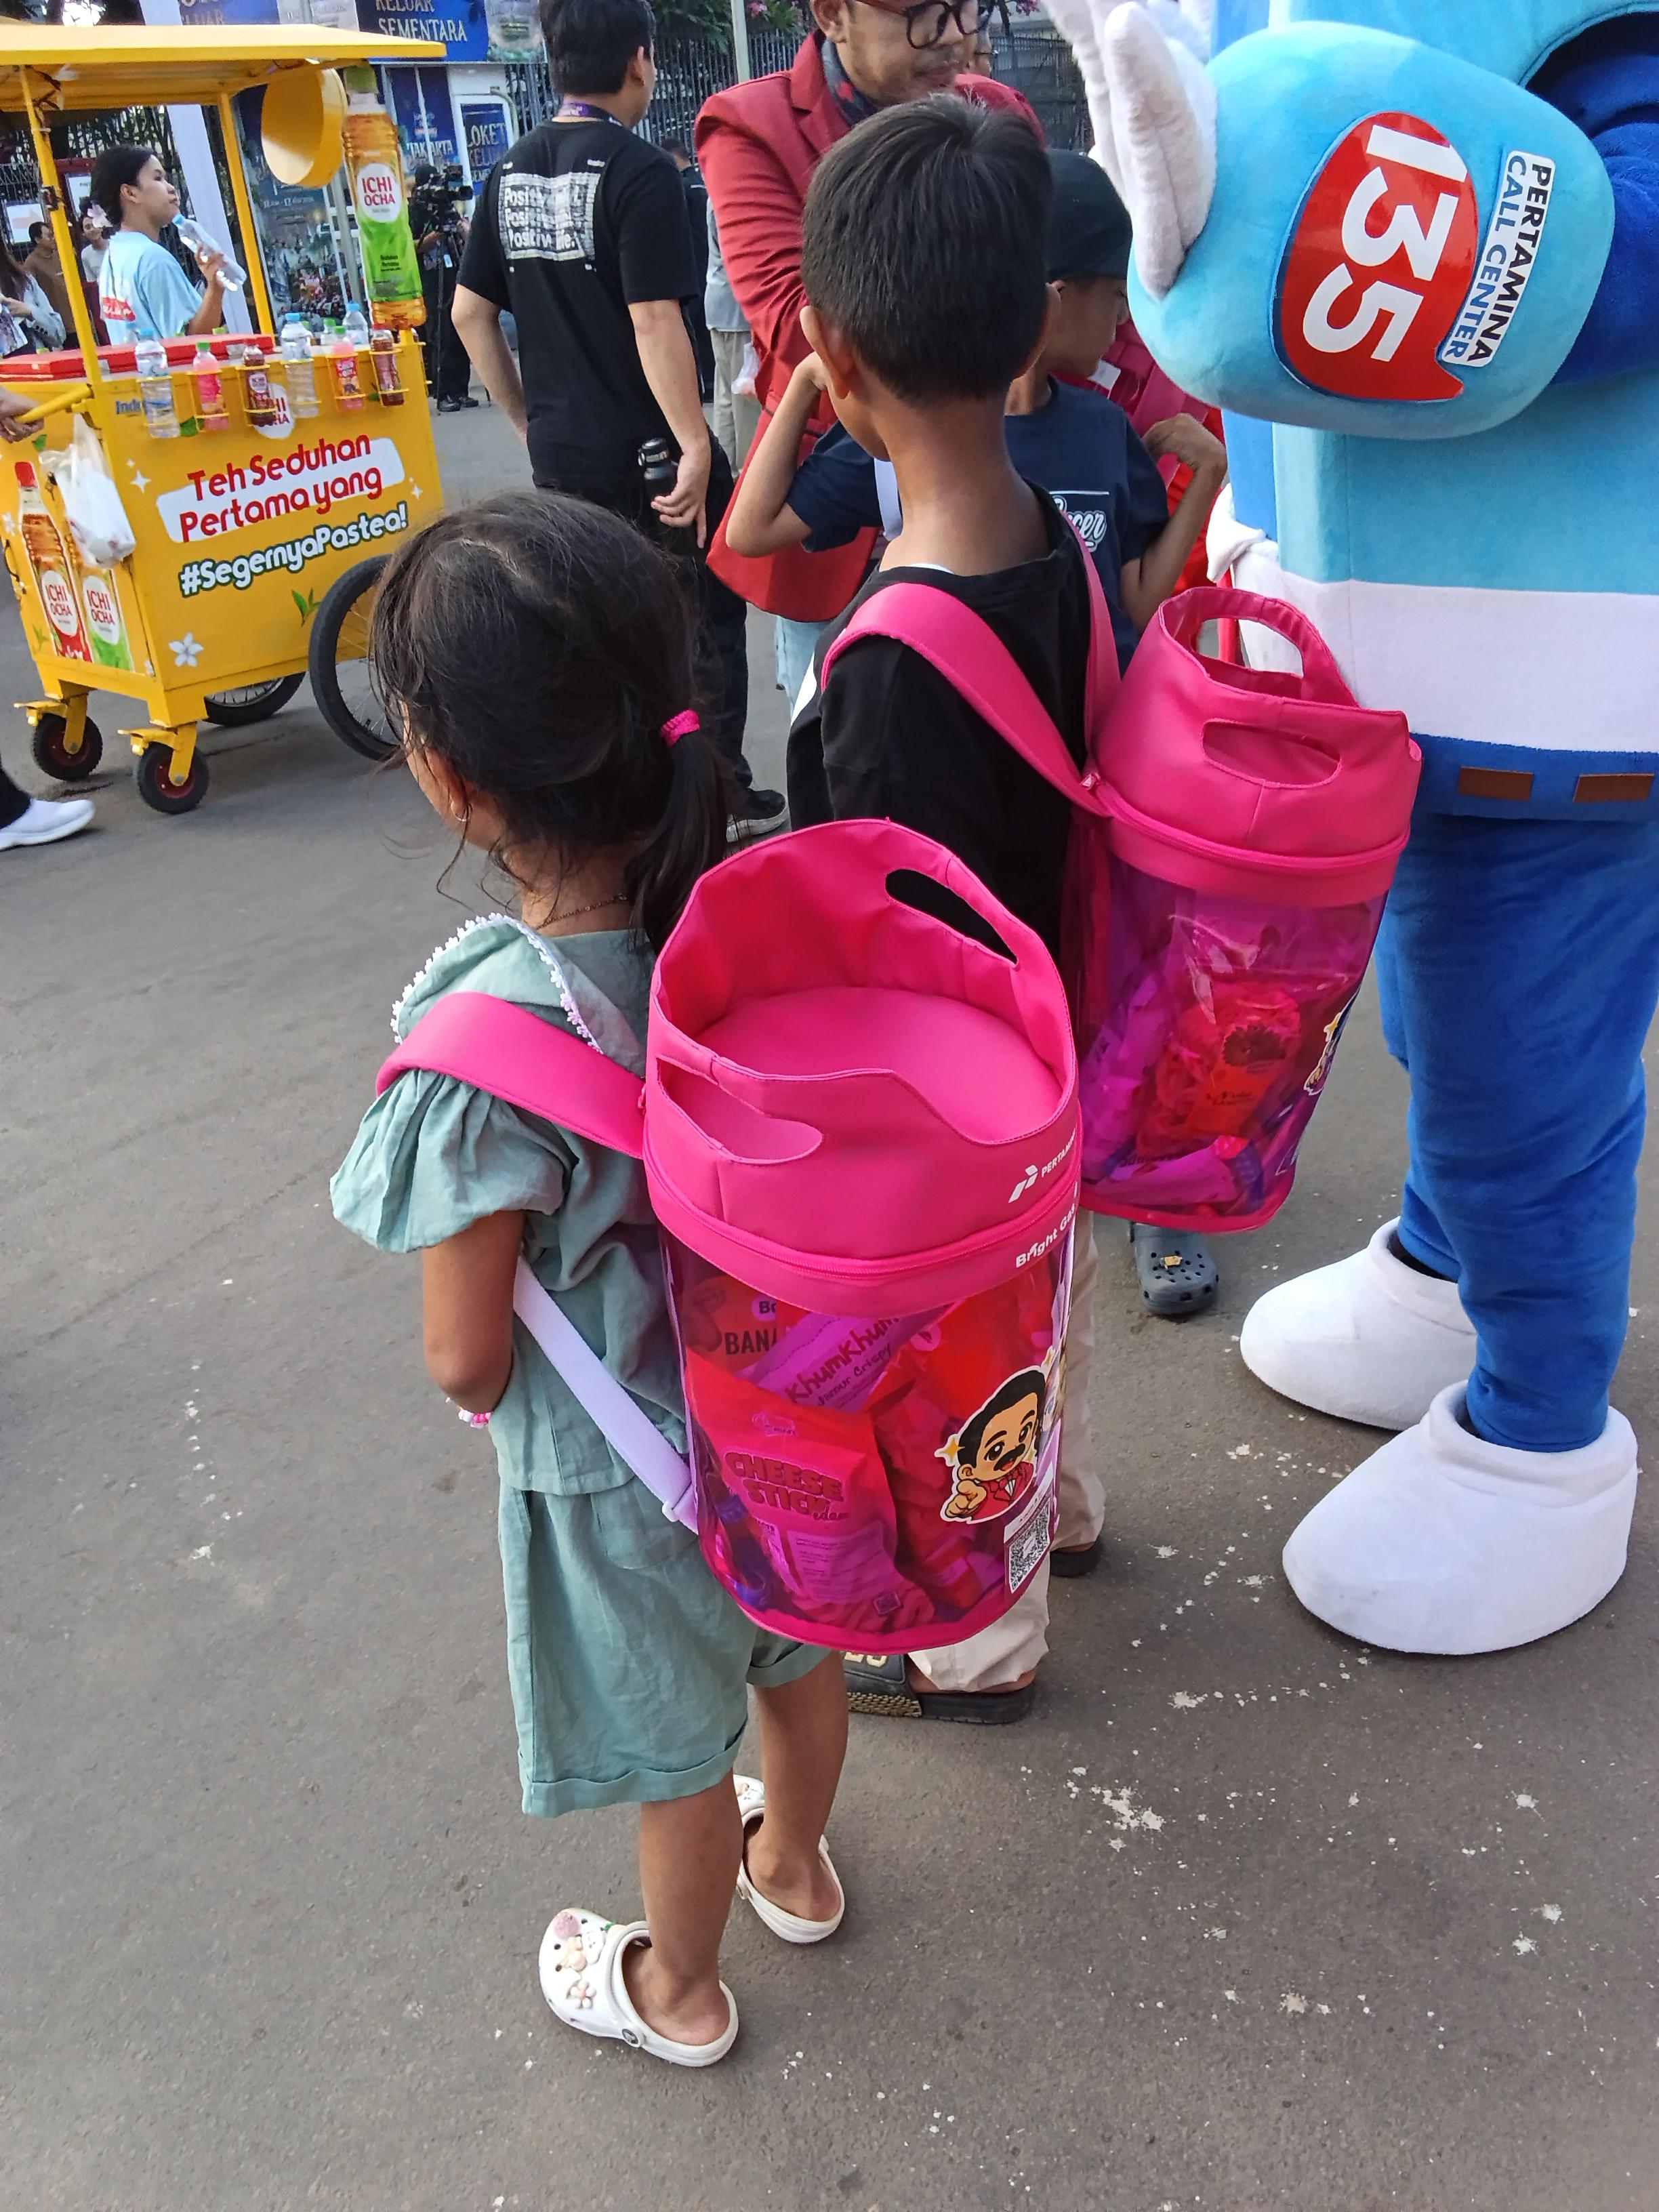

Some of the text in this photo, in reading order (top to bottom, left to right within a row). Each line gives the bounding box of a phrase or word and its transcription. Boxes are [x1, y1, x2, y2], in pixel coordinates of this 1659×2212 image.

[378, 18, 468, 41] SEMENTARA
[362, 176, 392, 193] ICHI
[364, 194, 395, 206] OCHA
[1303, 125, 1467, 362] 135
[1444, 155, 1527, 358] CALL CENTER
[1467, 163, 1552, 362] PERTAMINA
[187, 434, 371, 501] Teh Seduhan
[180, 468, 382, 542] Pertama yang
[180, 502, 408, 596] #SegernyaPastea!
[45, 584, 68, 602] ICHI
[50, 603, 73, 616] OCHA
[86, 590, 111, 611] ICHI
[91, 609, 115, 625] OCHA
[1016, 1203, 1076, 1268] Bright Gas
[853, 1343, 892, 1377] Crispy
[724, 1452, 844, 1502] CHEESE
[743, 1479, 832, 1515] STICK
